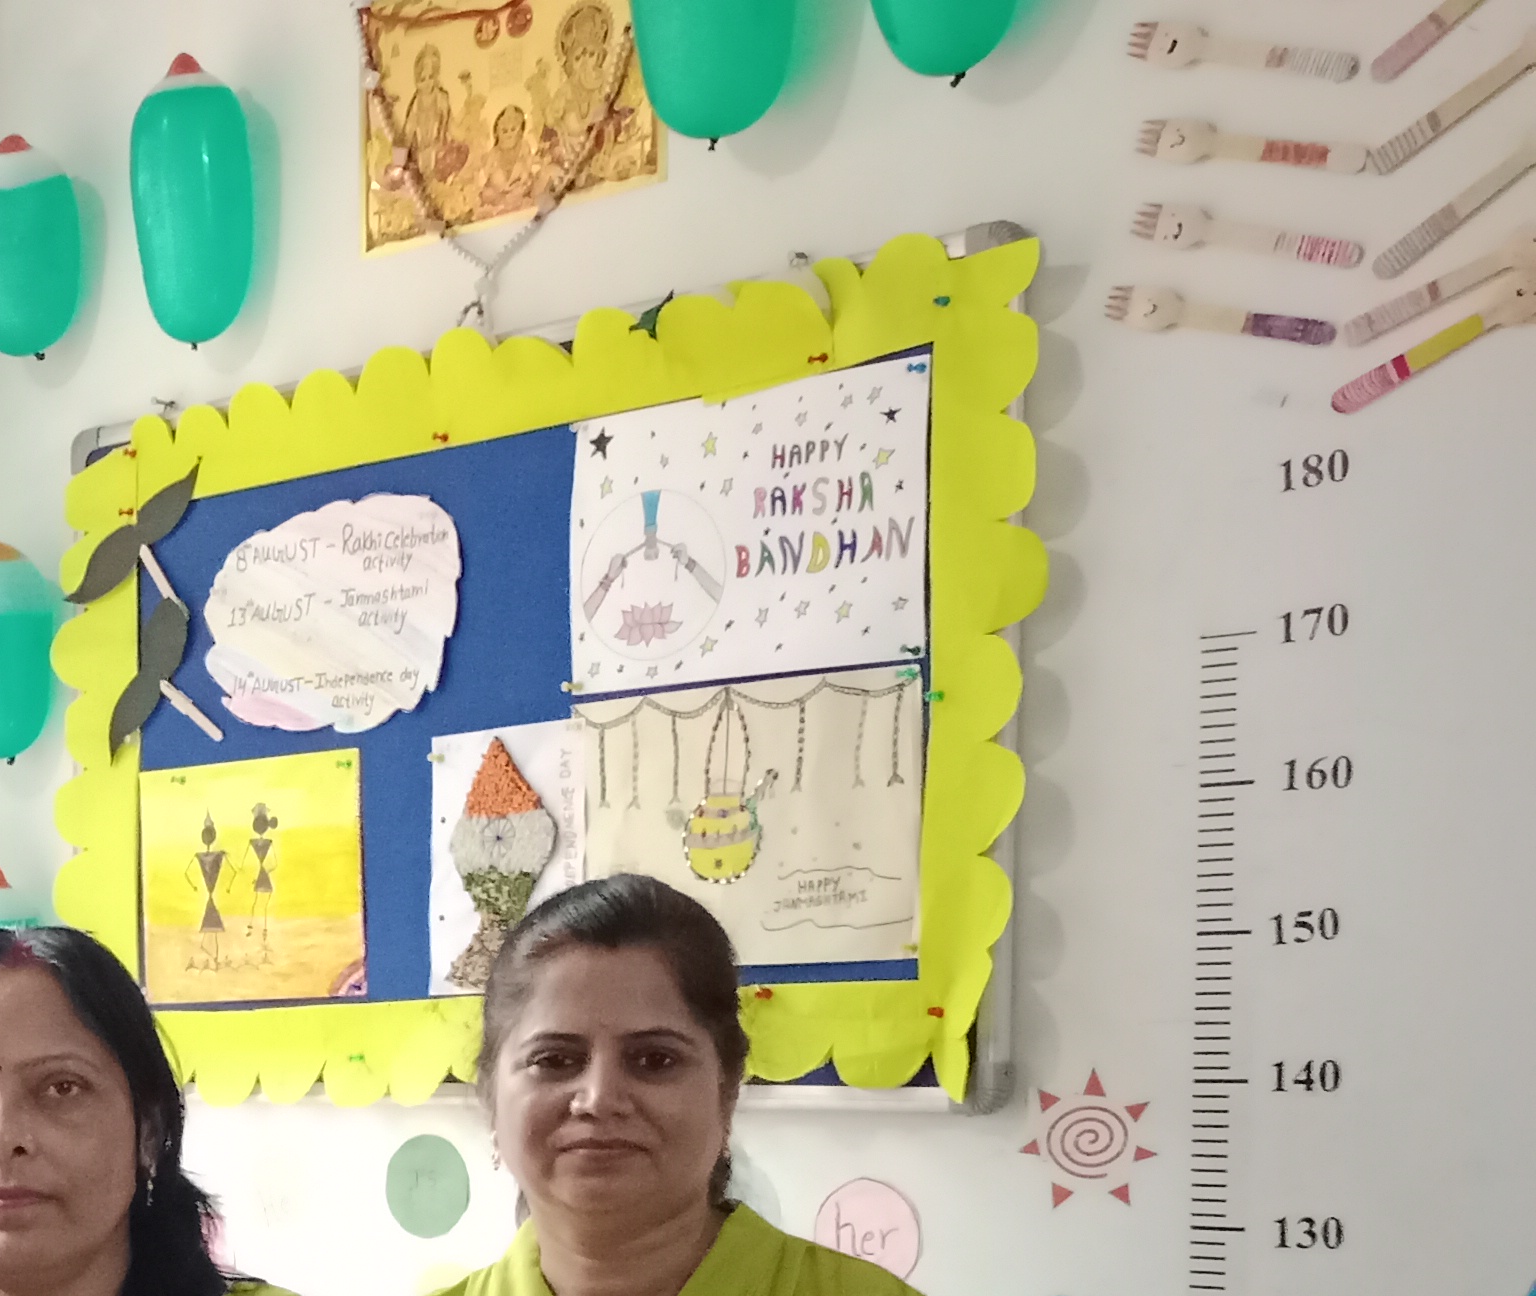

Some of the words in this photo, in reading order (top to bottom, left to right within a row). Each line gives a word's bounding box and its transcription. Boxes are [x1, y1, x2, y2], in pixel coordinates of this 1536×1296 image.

[771, 433, 848, 469] HAPPY
[1279, 449, 1349, 493] 180
[752, 471, 874, 519] RAKSHA
[341, 522, 383, 555] Rakhi
[735, 516, 915, 578] BANDHAN
[363, 552, 412, 573] activity
[358, 608, 407, 635] activity
[1278, 603, 1349, 644] 170
[400, 667, 420, 690] day
[331, 692, 375, 716] activity
[559, 748, 572, 779] DAY
[1282, 755, 1353, 792] 160
[797, 876, 841, 894] HAPPY
[1269, 907, 1340, 946] 150
[1270, 1059, 1342, 1093] 140
[833, 1202, 900, 1257] her
[1273, 1216, 1345, 1250] 130
